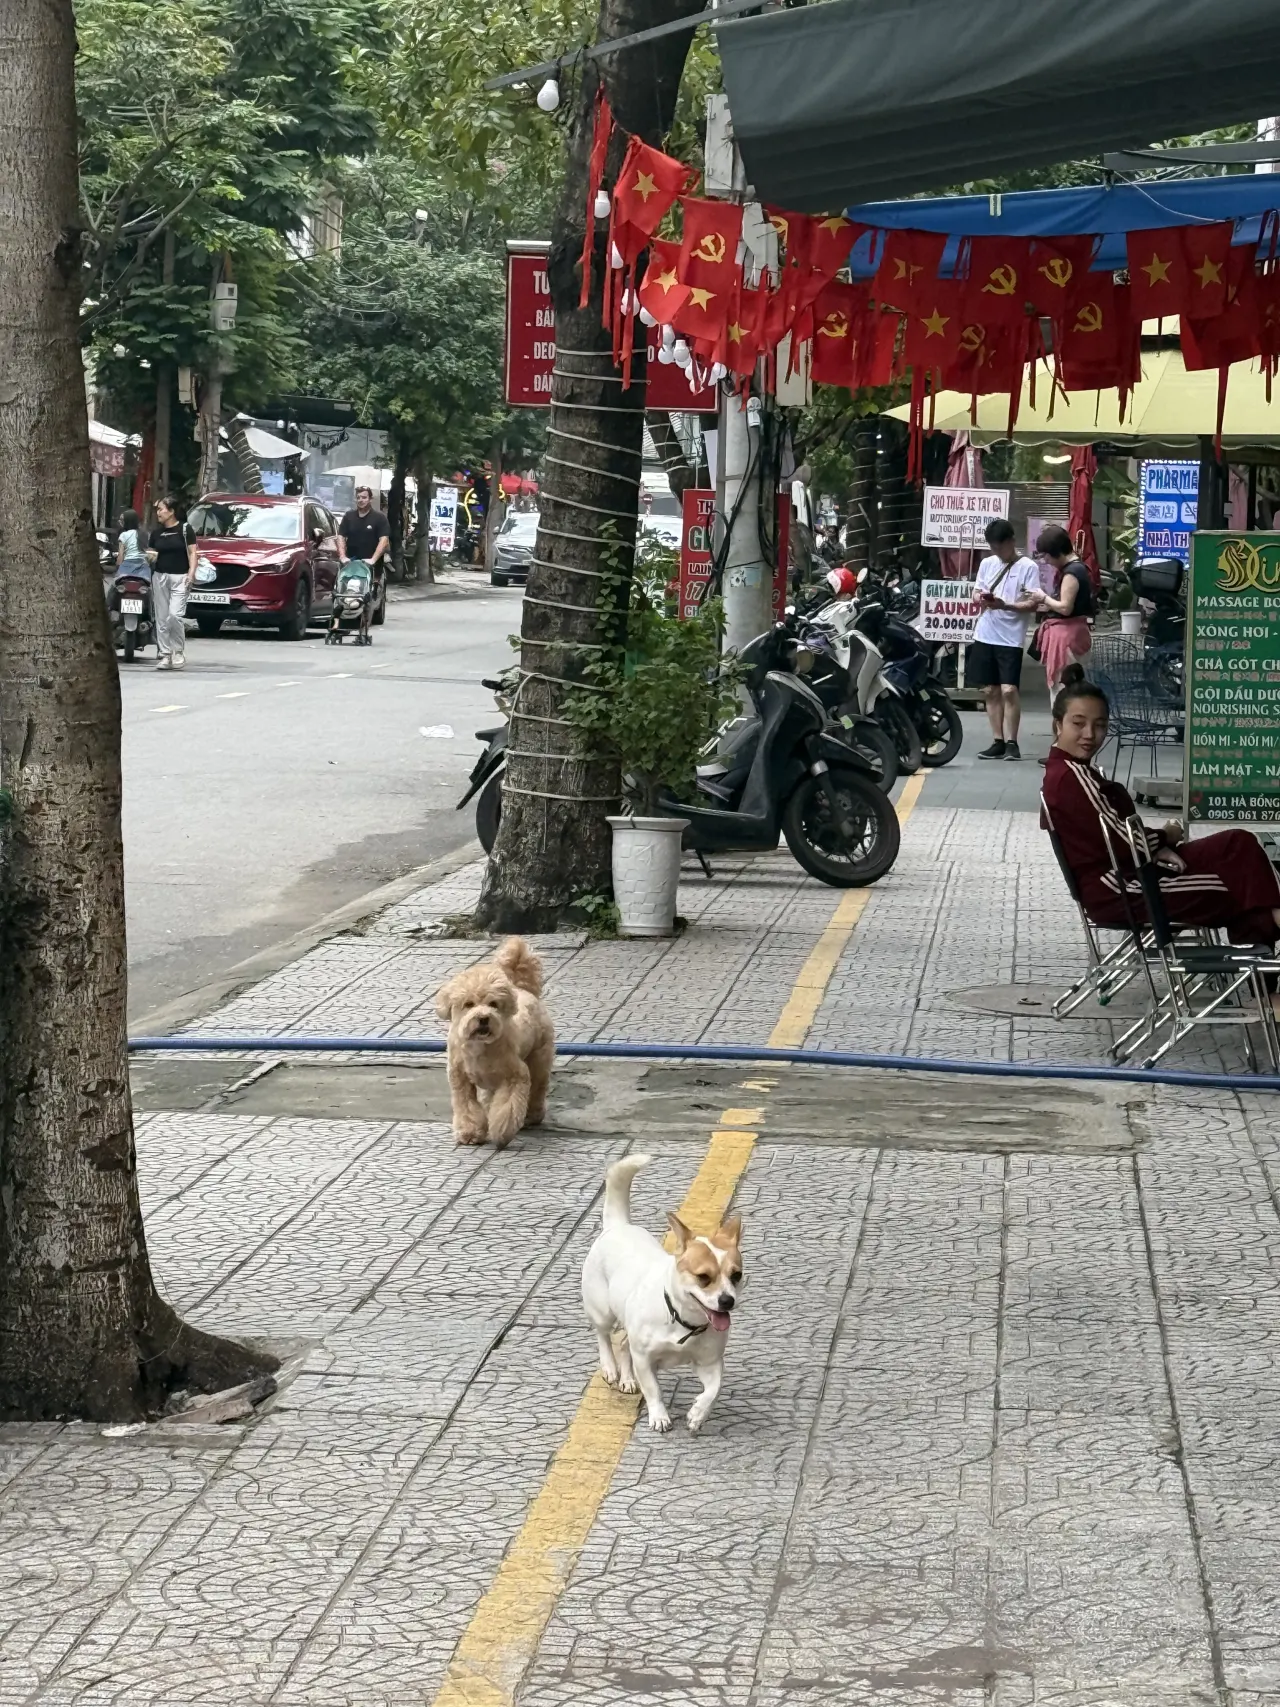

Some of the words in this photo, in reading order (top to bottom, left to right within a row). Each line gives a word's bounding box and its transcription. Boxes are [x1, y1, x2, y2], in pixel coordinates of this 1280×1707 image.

[966, 496, 975, 511] XE
[978, 497, 991, 512] TAY
[993, 498, 1001, 512] GA
[1147, 529, 1171, 547] NHÀ
[924, 600, 981, 616] LAUND
[1196, 596, 1260, 608] MASSAGE
[1195, 623, 1239, 637] XÔNG
[1242, 626, 1269, 638] HƠI
[1195, 656, 1224, 670] CHÀ
[1193, 686, 1220, 701] GỘI
[1193, 703, 1269, 715] NOURISHING
[1193, 732, 1216, 746] UỐN
[1218, 735, 1230, 746] MI
[1239, 733, 1259, 747] NỐI
[1192, 761, 1220, 775] LÀM
[1208, 797, 1227, 806] 101
[1231, 794, 1247, 807] HÀ
[1249, 793, 1280, 807] BỔNG
[1207, 809, 1235, 819] 0905
[1237, 810, 1257, 820] 061
